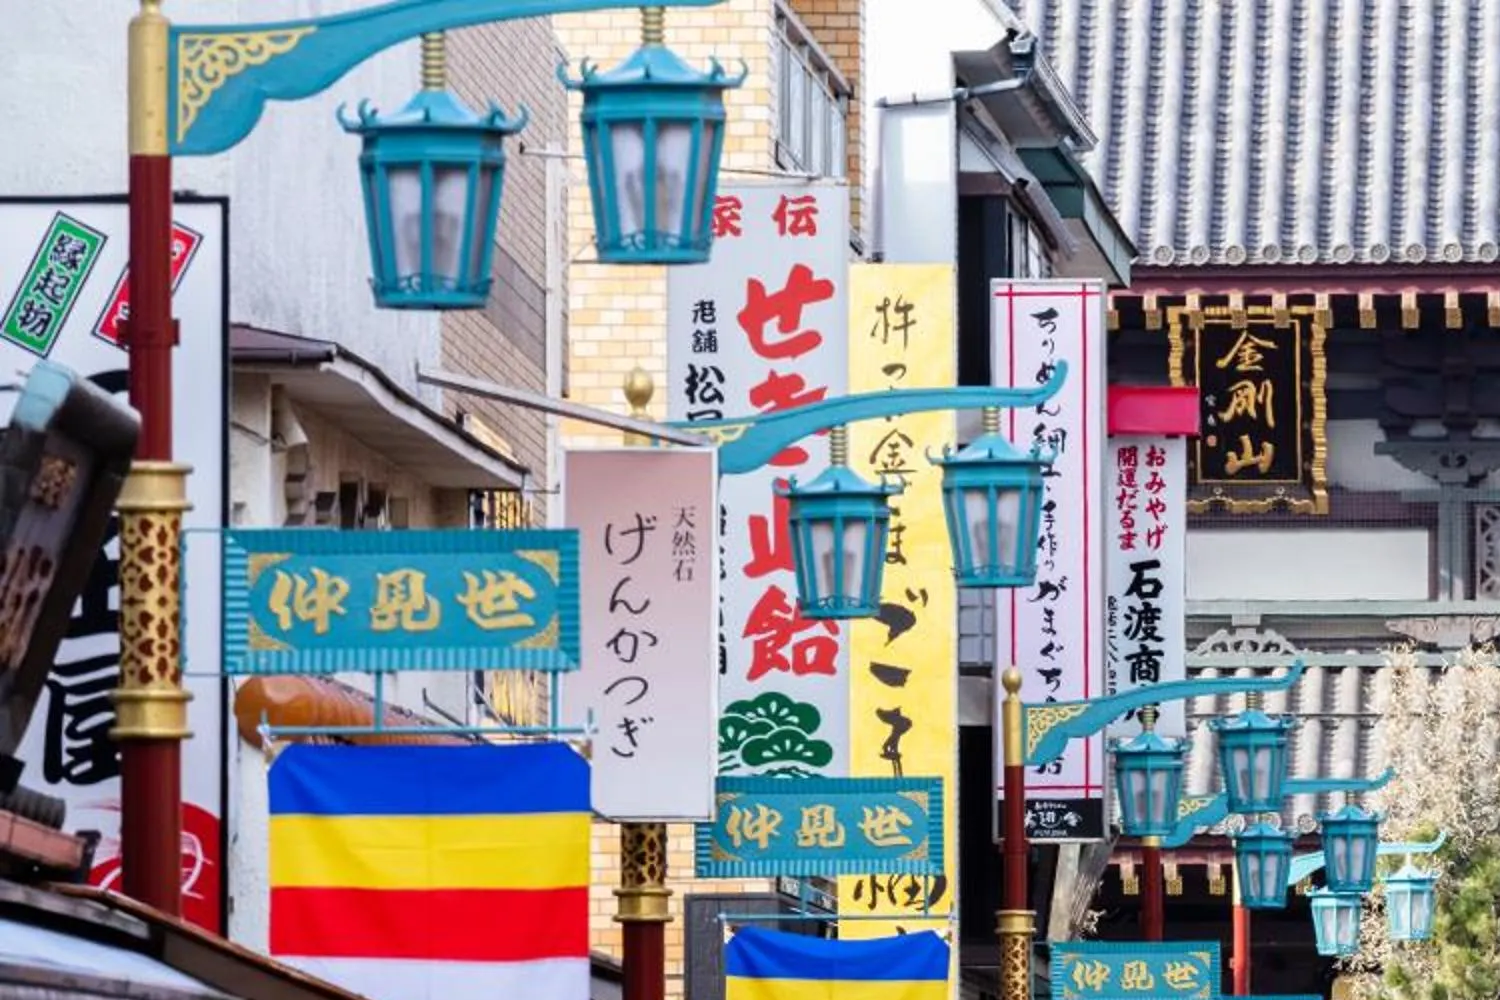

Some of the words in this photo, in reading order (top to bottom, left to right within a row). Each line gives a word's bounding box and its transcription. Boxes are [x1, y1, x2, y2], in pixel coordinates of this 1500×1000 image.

[14, 232, 90, 338] 縁起物
[1216, 329, 1278, 475] 金剛山
[672, 505, 697, 582] 天然石
[1116, 445, 1140, 550] 開運だるま
[1144, 444, 1169, 550] おみやげ
[268, 567, 536, 635] 仲見世
[604, 512, 658, 758] げんかつぎ
[726, 803, 913, 850] 仲見世
[1072, 959, 1199, 991] 仲見世
